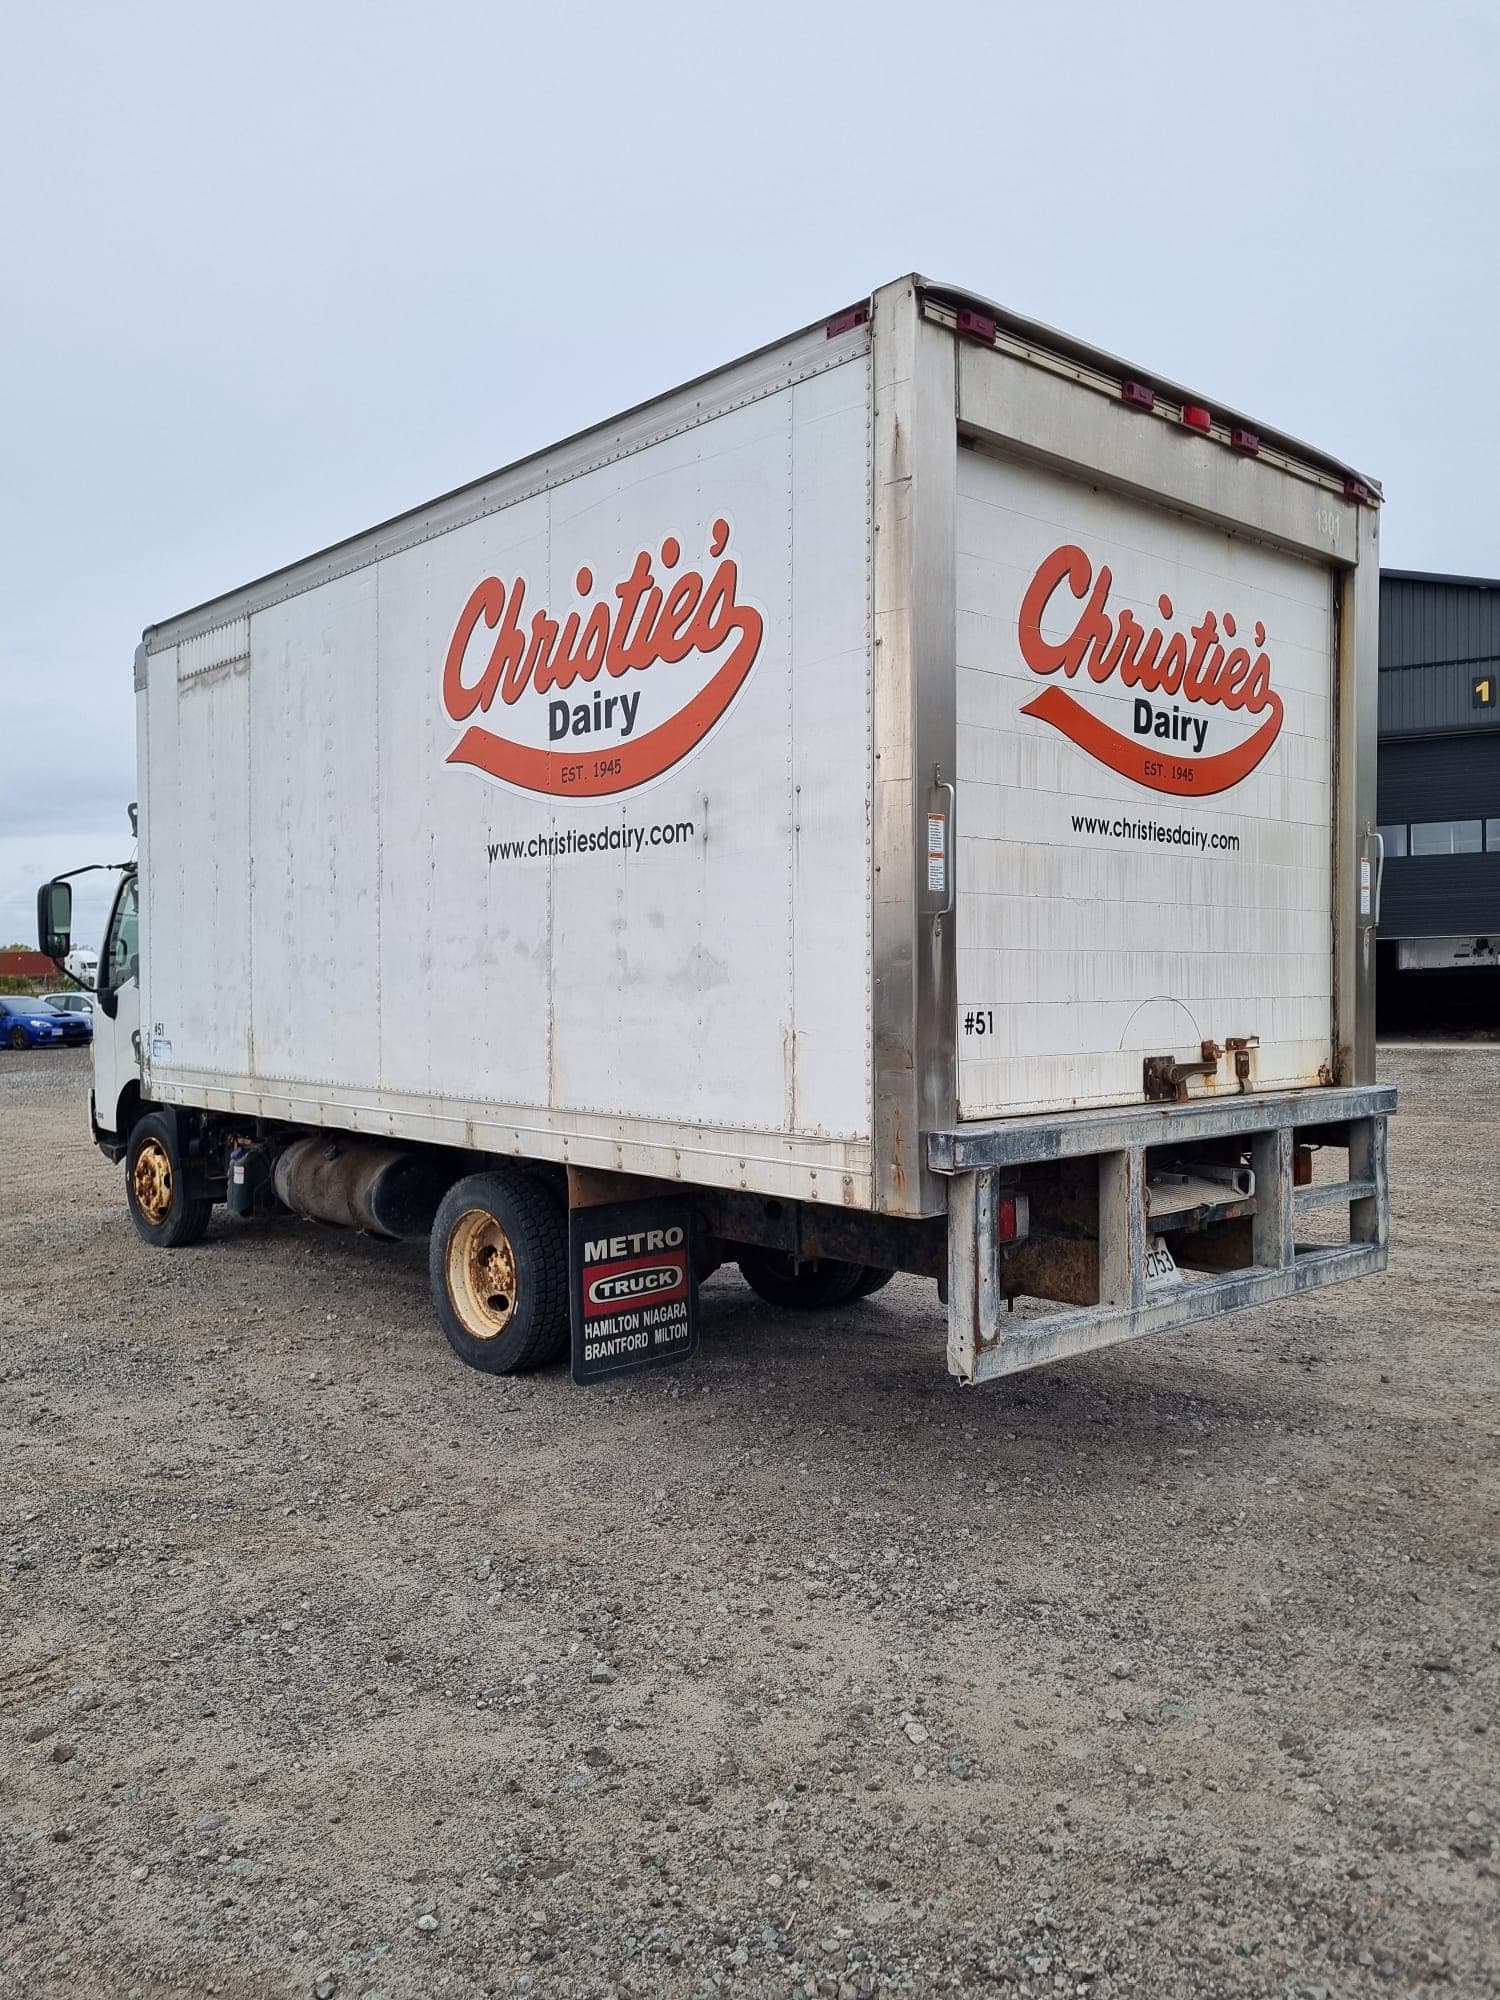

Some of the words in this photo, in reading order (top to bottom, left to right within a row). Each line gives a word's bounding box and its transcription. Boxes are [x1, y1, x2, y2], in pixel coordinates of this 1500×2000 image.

[1315, 510, 1340, 537] 1301
[443, 518, 763, 722] Christie's
[1018, 544, 1284, 714] Christie's
[1475, 680, 1490, 702] 1
[549, 690, 641, 741] Dairy
[1133, 698, 1209, 752] Dairy
[560, 767, 588, 783] EST.
[593, 758, 623, 778] 1945
[1144, 760, 1168, 780] EST.
[1171, 765, 1194, 782] 1945
[487, 821, 694, 863] www.christiesdairy.com
[1071, 815, 1240, 851] www.christiesdairy.com
[964, 1011, 993, 1035] #51
[584, 1226, 684, 1263] METRO
[1144, 1250, 1174, 1279] 2753
[599, 1271, 673, 1297] TRUCK
[584, 1313, 640, 1340] HAMILTON
[643, 1301, 687, 1327] NIAGARA
[584, 1332, 649, 1361] BRANTFORD
[654, 1321, 688, 1345] MILTON
